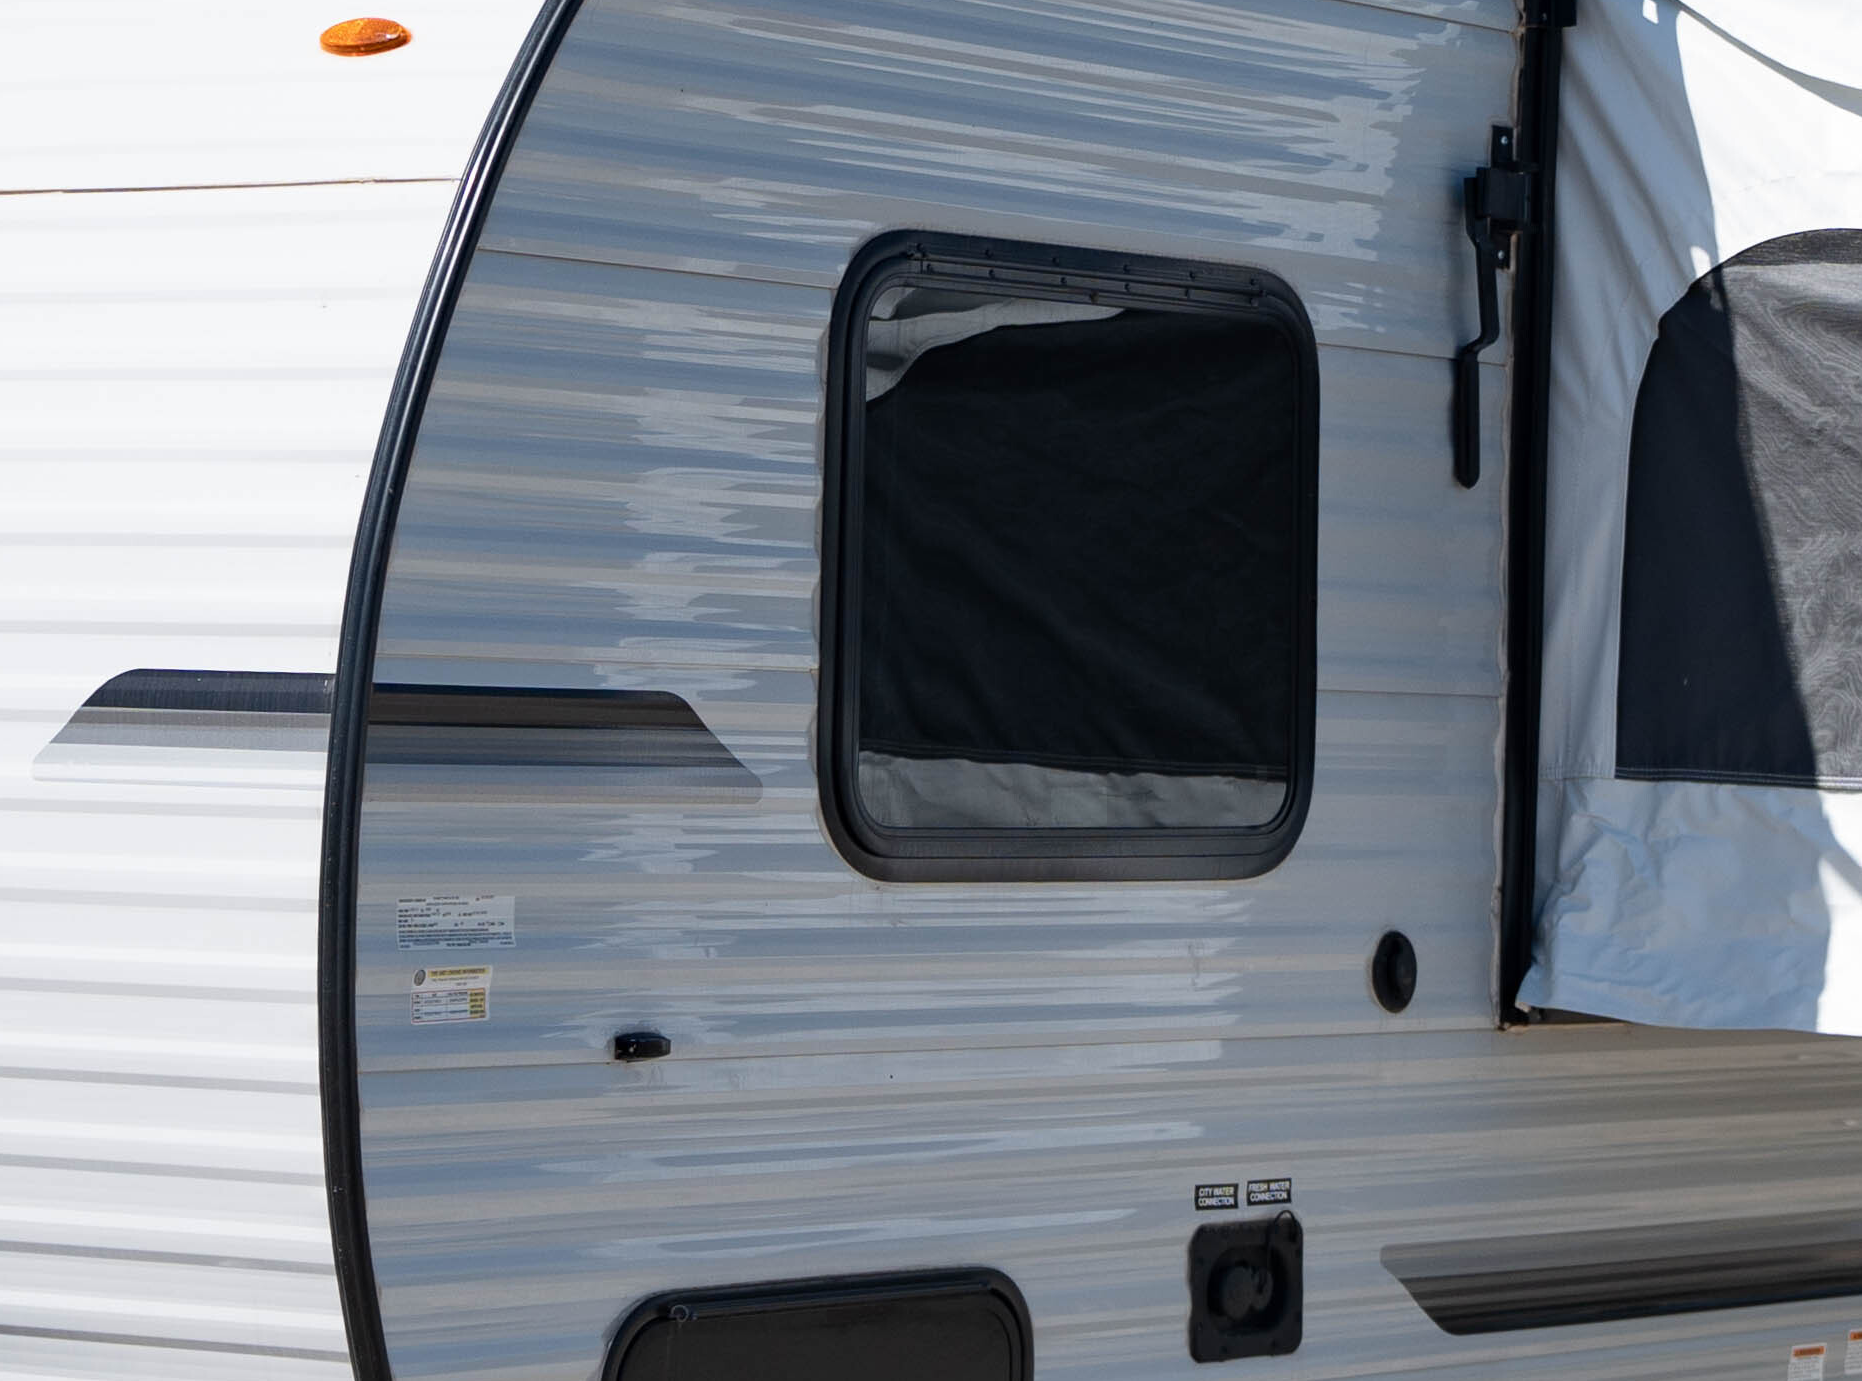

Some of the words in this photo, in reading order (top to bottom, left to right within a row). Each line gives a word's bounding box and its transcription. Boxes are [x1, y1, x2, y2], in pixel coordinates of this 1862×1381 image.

[1198, 1187, 1212, 1196] CITY
[1249, 1190, 1288, 1202] CONNECTION
[1198, 1195, 1235, 1206] CONNECTION
